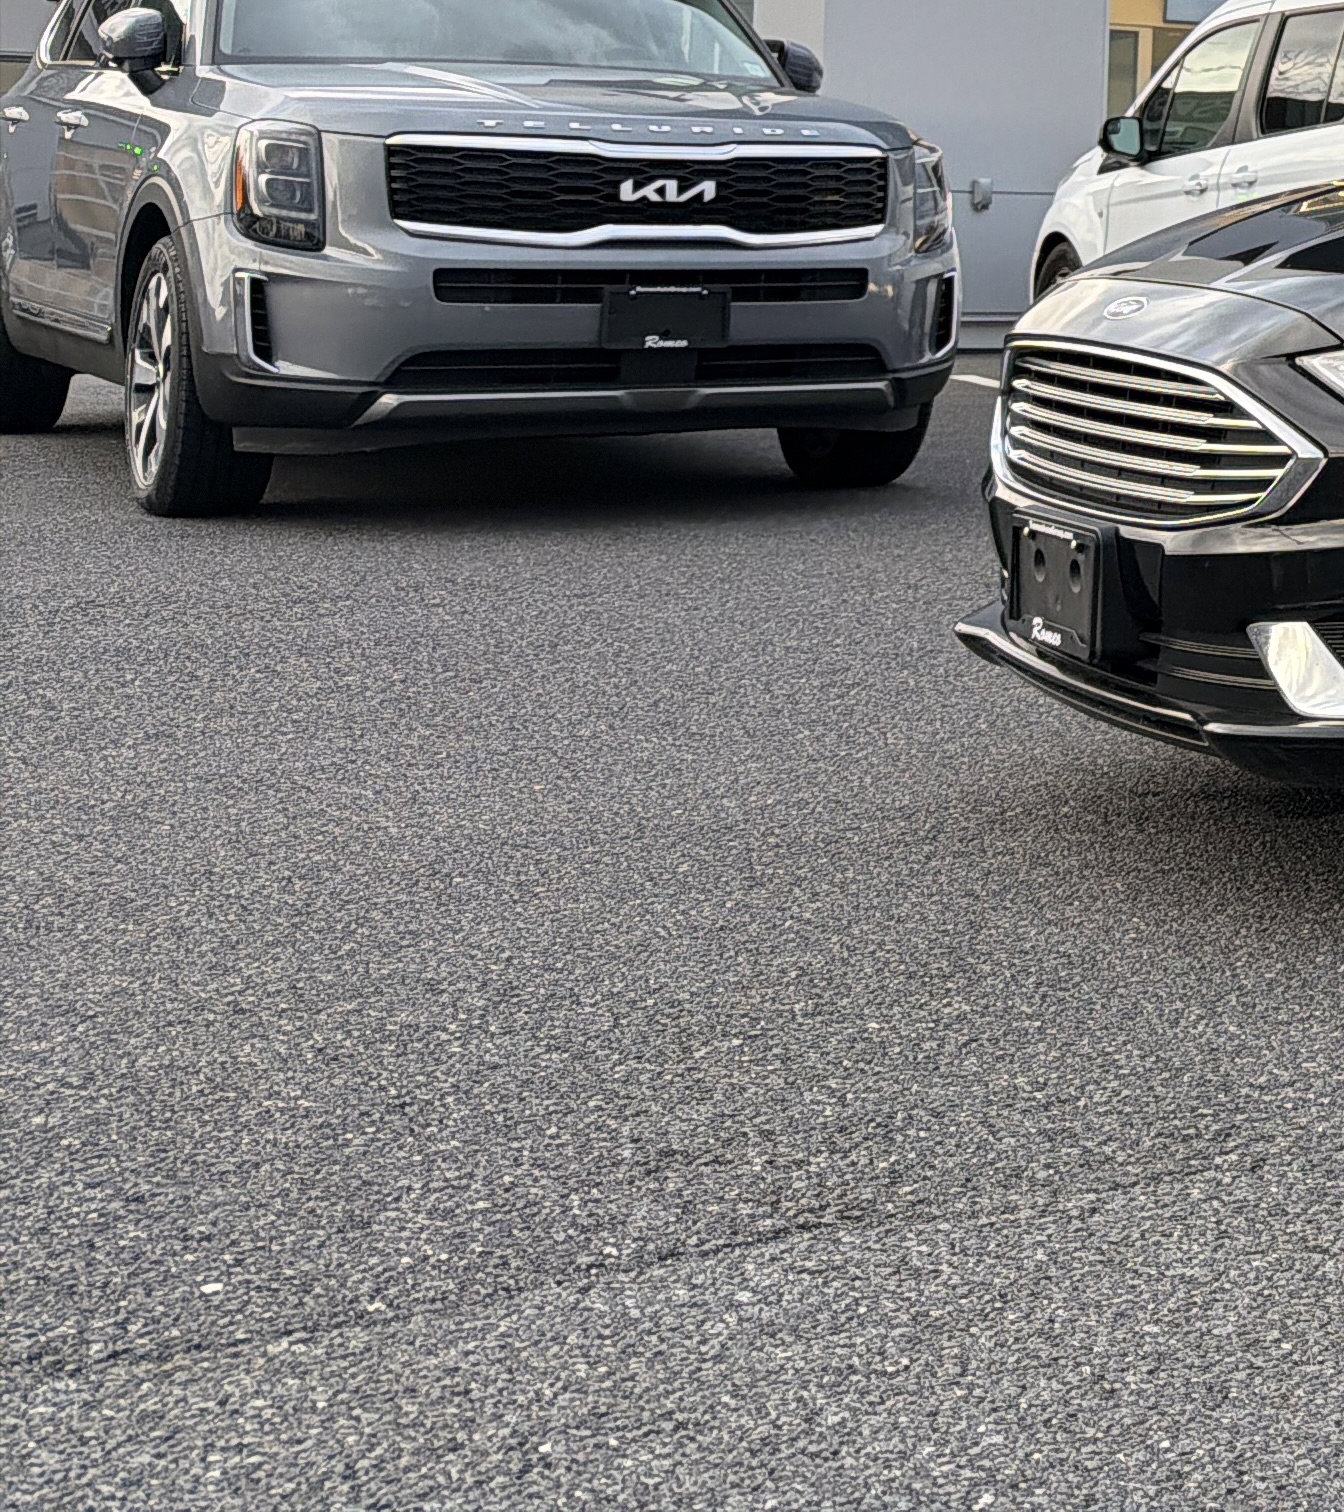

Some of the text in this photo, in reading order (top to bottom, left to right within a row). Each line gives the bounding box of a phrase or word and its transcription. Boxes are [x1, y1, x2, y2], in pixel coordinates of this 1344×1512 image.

[477, 119, 820, 136] TELLURIDE
[619, 179, 717, 203] KIA
[643, 335, 689, 348] Romeo
